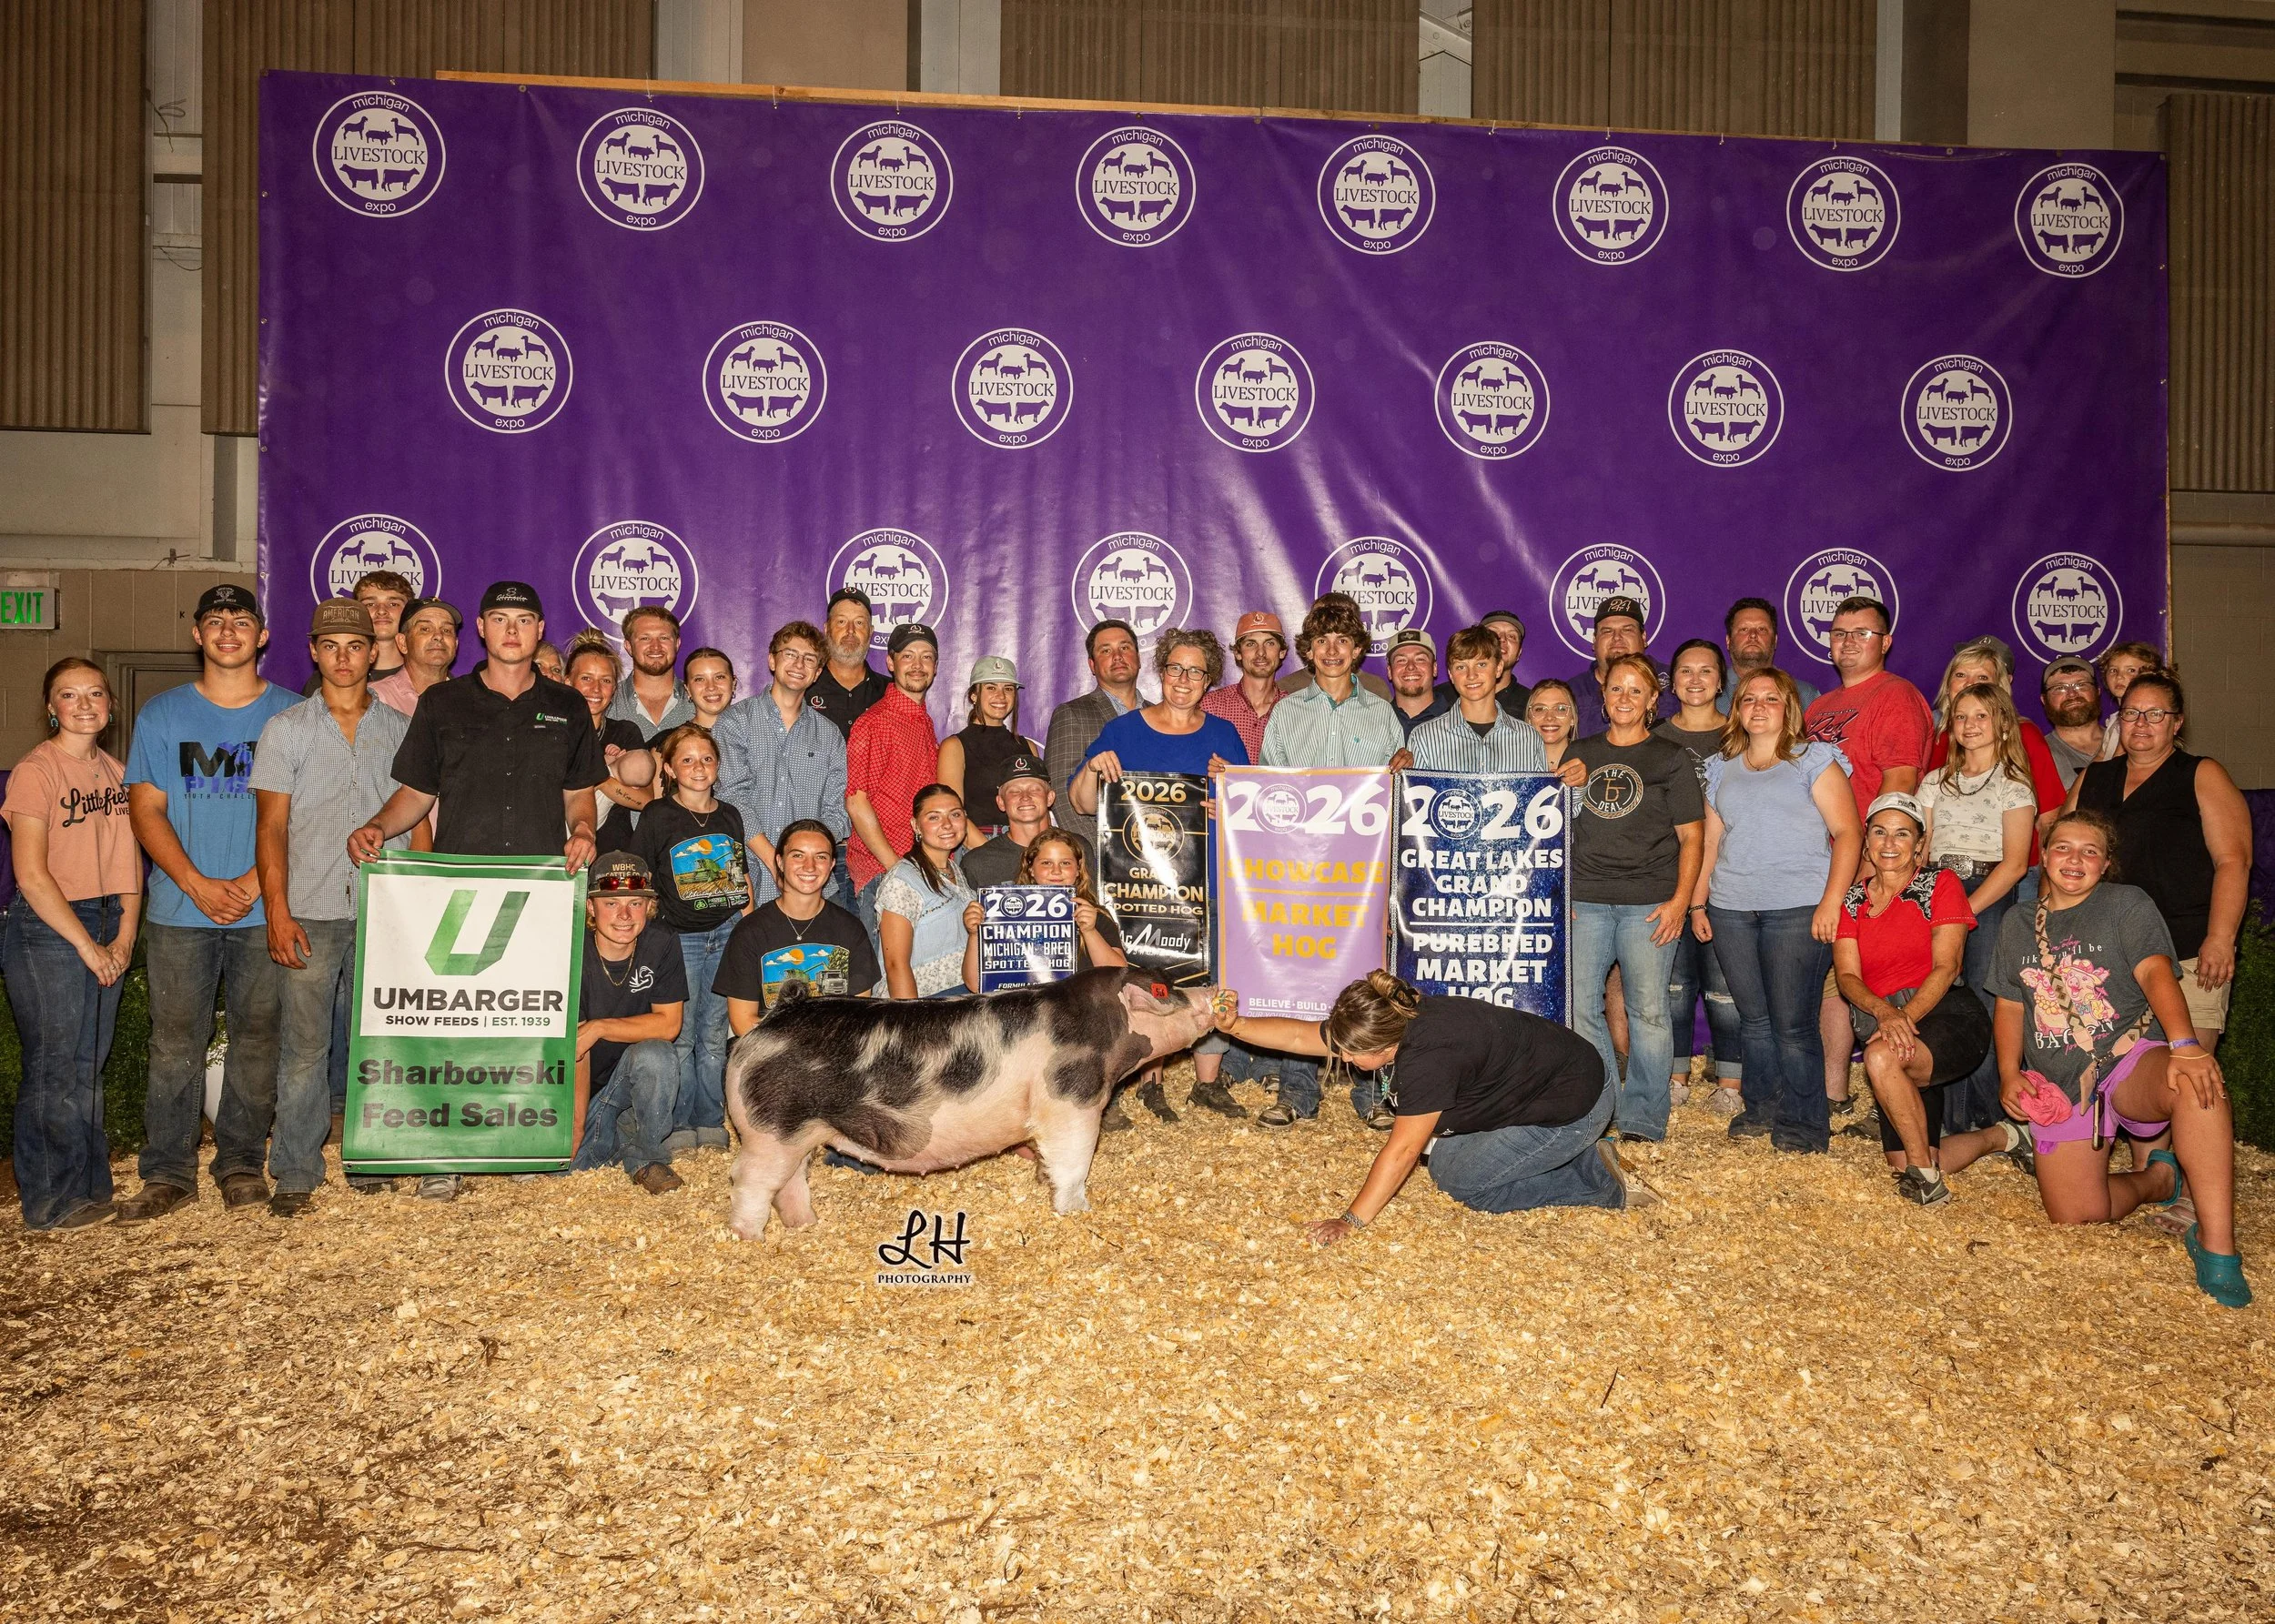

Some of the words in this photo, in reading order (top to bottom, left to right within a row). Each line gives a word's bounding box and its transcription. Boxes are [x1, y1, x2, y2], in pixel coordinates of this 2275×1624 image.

[353, 95, 410, 112] michigan
[615, 112, 670, 129] michigan
[868, 126, 919, 140] michigan
[1112, 130, 1163, 146] michigan
[1353, 138, 1403, 155] michigan
[335, 146, 424, 164] LIVESTOCK
[1588, 150, 1637, 166] michigan
[597, 160, 684, 179] LIVESTOCK
[1820, 160, 1869, 174] michigan
[2048, 168, 2097, 180] michigan
[850, 175, 934, 190] LIVESTOCK
[1095, 180, 1177, 195] LIVESTOCK
[1336, 188, 1417, 204] LIVESTOCK
[366, 201, 397, 214] expo
[1572, 199, 1651, 214] LIVESTOCK
[626, 215, 656, 225] expo
[1805, 207, 1882, 222] LIVESTOCK
[2033, 215, 2108, 227] LIVESTOCK
[878, 227, 906, 238] expo
[1123, 233, 1150, 241] expo
[1363, 240, 1390, 251] expo
[1598, 251, 1624, 262] expo
[1832, 257, 1857, 267] expo
[2058, 264, 2084, 275] expo
[484, 312, 539, 329] michigan
[741, 325, 794, 340] michigan
[988, 334, 1039, 347] michigan
[1231, 337, 1281, 351] michigan
[1470, 345, 1518, 360] michigan
[1703, 353, 1752, 368] michigan
[1935, 360, 1983, 373] michigan
[466, 364, 553, 379] LIVESTOCK
[723, 375, 807, 390] LIVESTOCK
[971, 382, 1054, 396] LIVESTOCK
[1215, 386, 1296, 400] LIVESTOCK
[1454, 393, 1532, 409] LIVESTOCK
[1687, 402, 1765, 416] LIVESTOCK
[1918, 407, 1995, 420] LIVESTOCK
[495, 419, 525, 429] expo
[752, 429, 780, 439] expo
[999, 435, 1026, 445] expo
[1242, 439, 1269, 449] expo
[1481, 446, 1507, 456] expo
[1713, 453, 1740, 464] expo
[1946, 458, 1970, 468] expo
[349, 518, 406, 534] michigan
[611, 524, 663, 540] michigan
[863, 534, 915, 547] michigan
[1108, 535, 1159, 550] michigan
[1350, 540, 1401, 556] michigan
[1584, 548, 1634, 562] michigan
[1818, 551, 1867, 567] michigan
[2046, 555, 2093, 570] michigan
[592, 575, 679, 590] LIVESTOCK
[1091, 586, 1173, 600] LIVESTOCK
[0, 592, 44, 624] EXIT
[2030, 604, 2105, 618] LIVESTOCK
[1604, 769, 1626, 779] THE
[1121, 781, 1187, 802] 2026
[60, 788, 130, 828] Littlefiel
[1597, 801, 1623, 812] DEAL
[1439, 810, 1474, 819] LIVESTOCK
[1400, 849, 1481, 870] GREAT
[1486, 848, 1563, 870] LAKES
[1228, 858, 1384, 883] SHOWCASE
[1436, 874, 1528, 893] GRAND
[1105, 883, 1204, 902] CHAMPION
[1170, 906, 1203, 915] HOG
[1242, 901, 1369, 928] MARKET
[1412, 897, 1552, 918] CHAMPION
[984, 924, 1071, 940] CHAMPION
[1272, 933, 1337, 959] HOG
[1412, 933, 1552, 953] PUREBRED
[2022, 954, 2038, 964] lik
[2089, 943, 2102, 953] be
[985, 959, 1029, 970] SPOTTE
[1049, 959, 1070, 968] HOG
[1416, 959, 1548, 983] MARKET
[374, 988, 563, 1012] UMBARGER
[1249, 997, 1291, 1009] BELIEVE
[1297, 1000, 1327, 1011] BUILD
[386, 1015, 430, 1026] SHOW
[434, 1016, 479, 1026] FEEDS
[491, 1016, 518, 1026] EST.
[521, 1017, 551, 1026] 1939
[357, 1059, 565, 1085] Sharbowski
[362, 1102, 450, 1128] Feed
[460, 1102, 559, 1127] Sales
